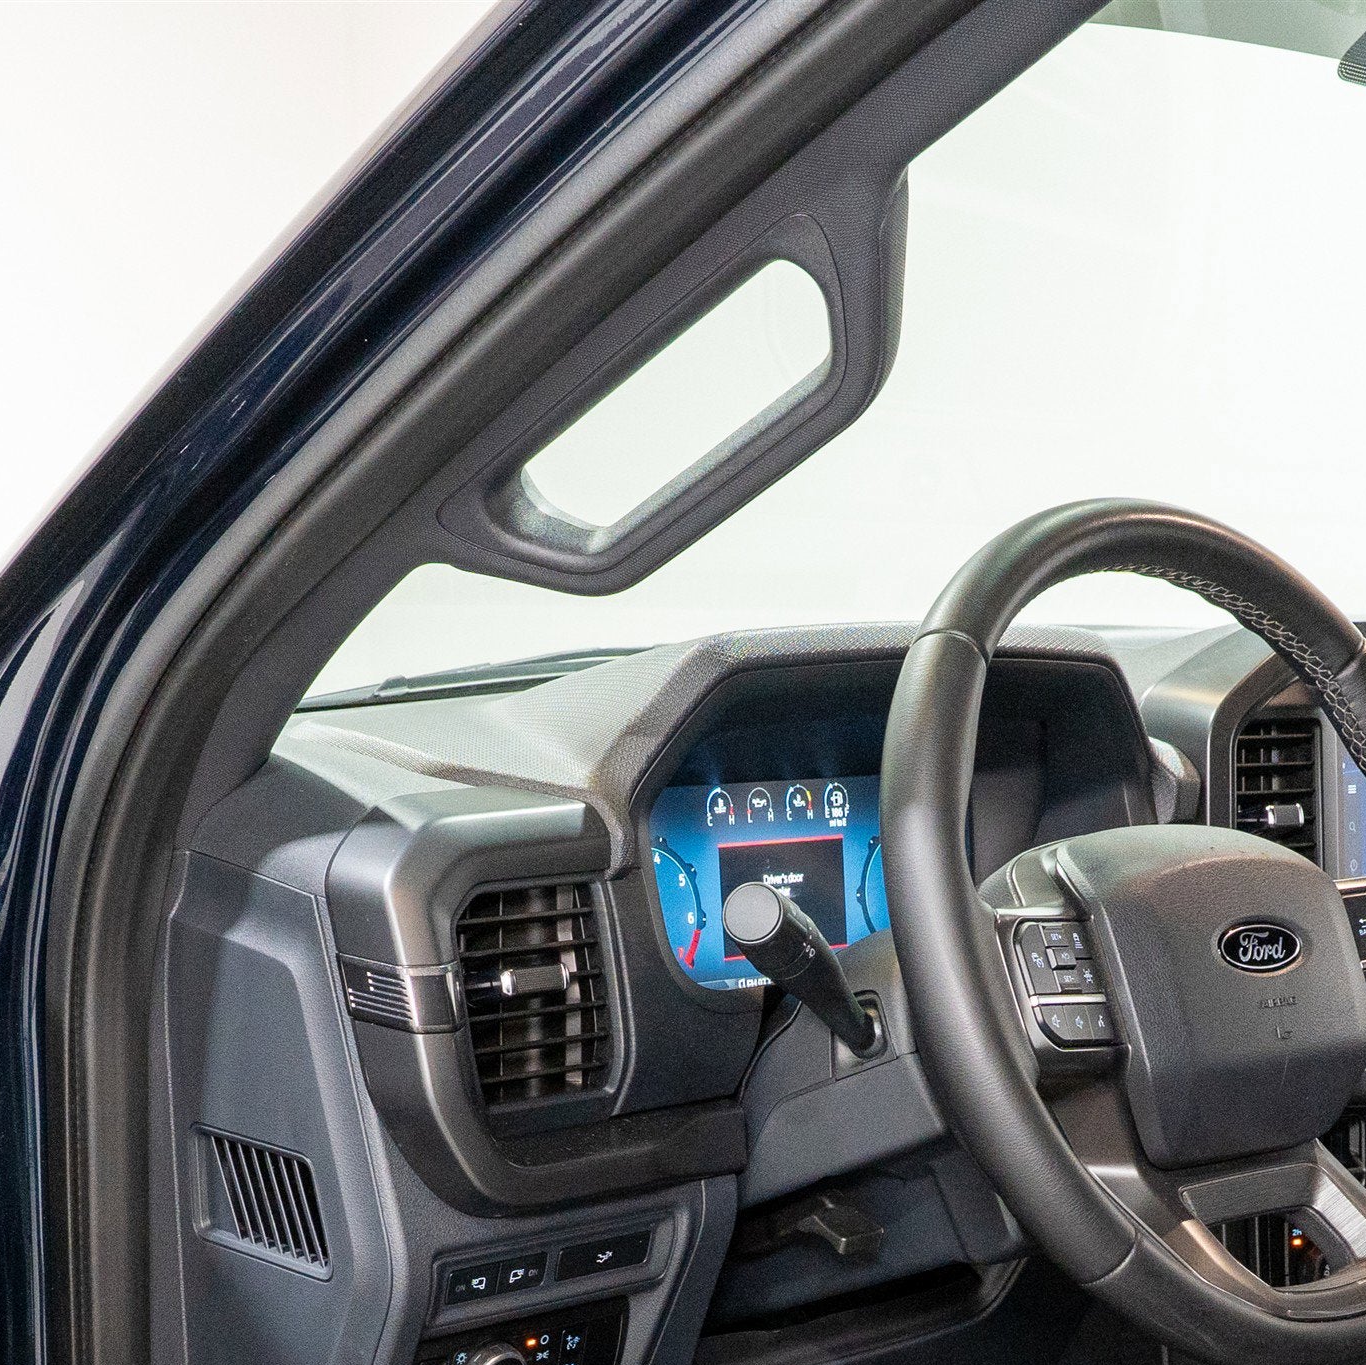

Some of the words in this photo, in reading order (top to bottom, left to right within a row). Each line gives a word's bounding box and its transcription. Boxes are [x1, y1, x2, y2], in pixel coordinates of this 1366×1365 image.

[654, 852, 660, 864] 4
[678, 874, 685, 887] 5
[687, 912, 694, 924] 6
[1239, 931, 1286, 962] Ford
[528, 1269, 539, 1277] ON
[455, 1284, 466, 1292] ON
